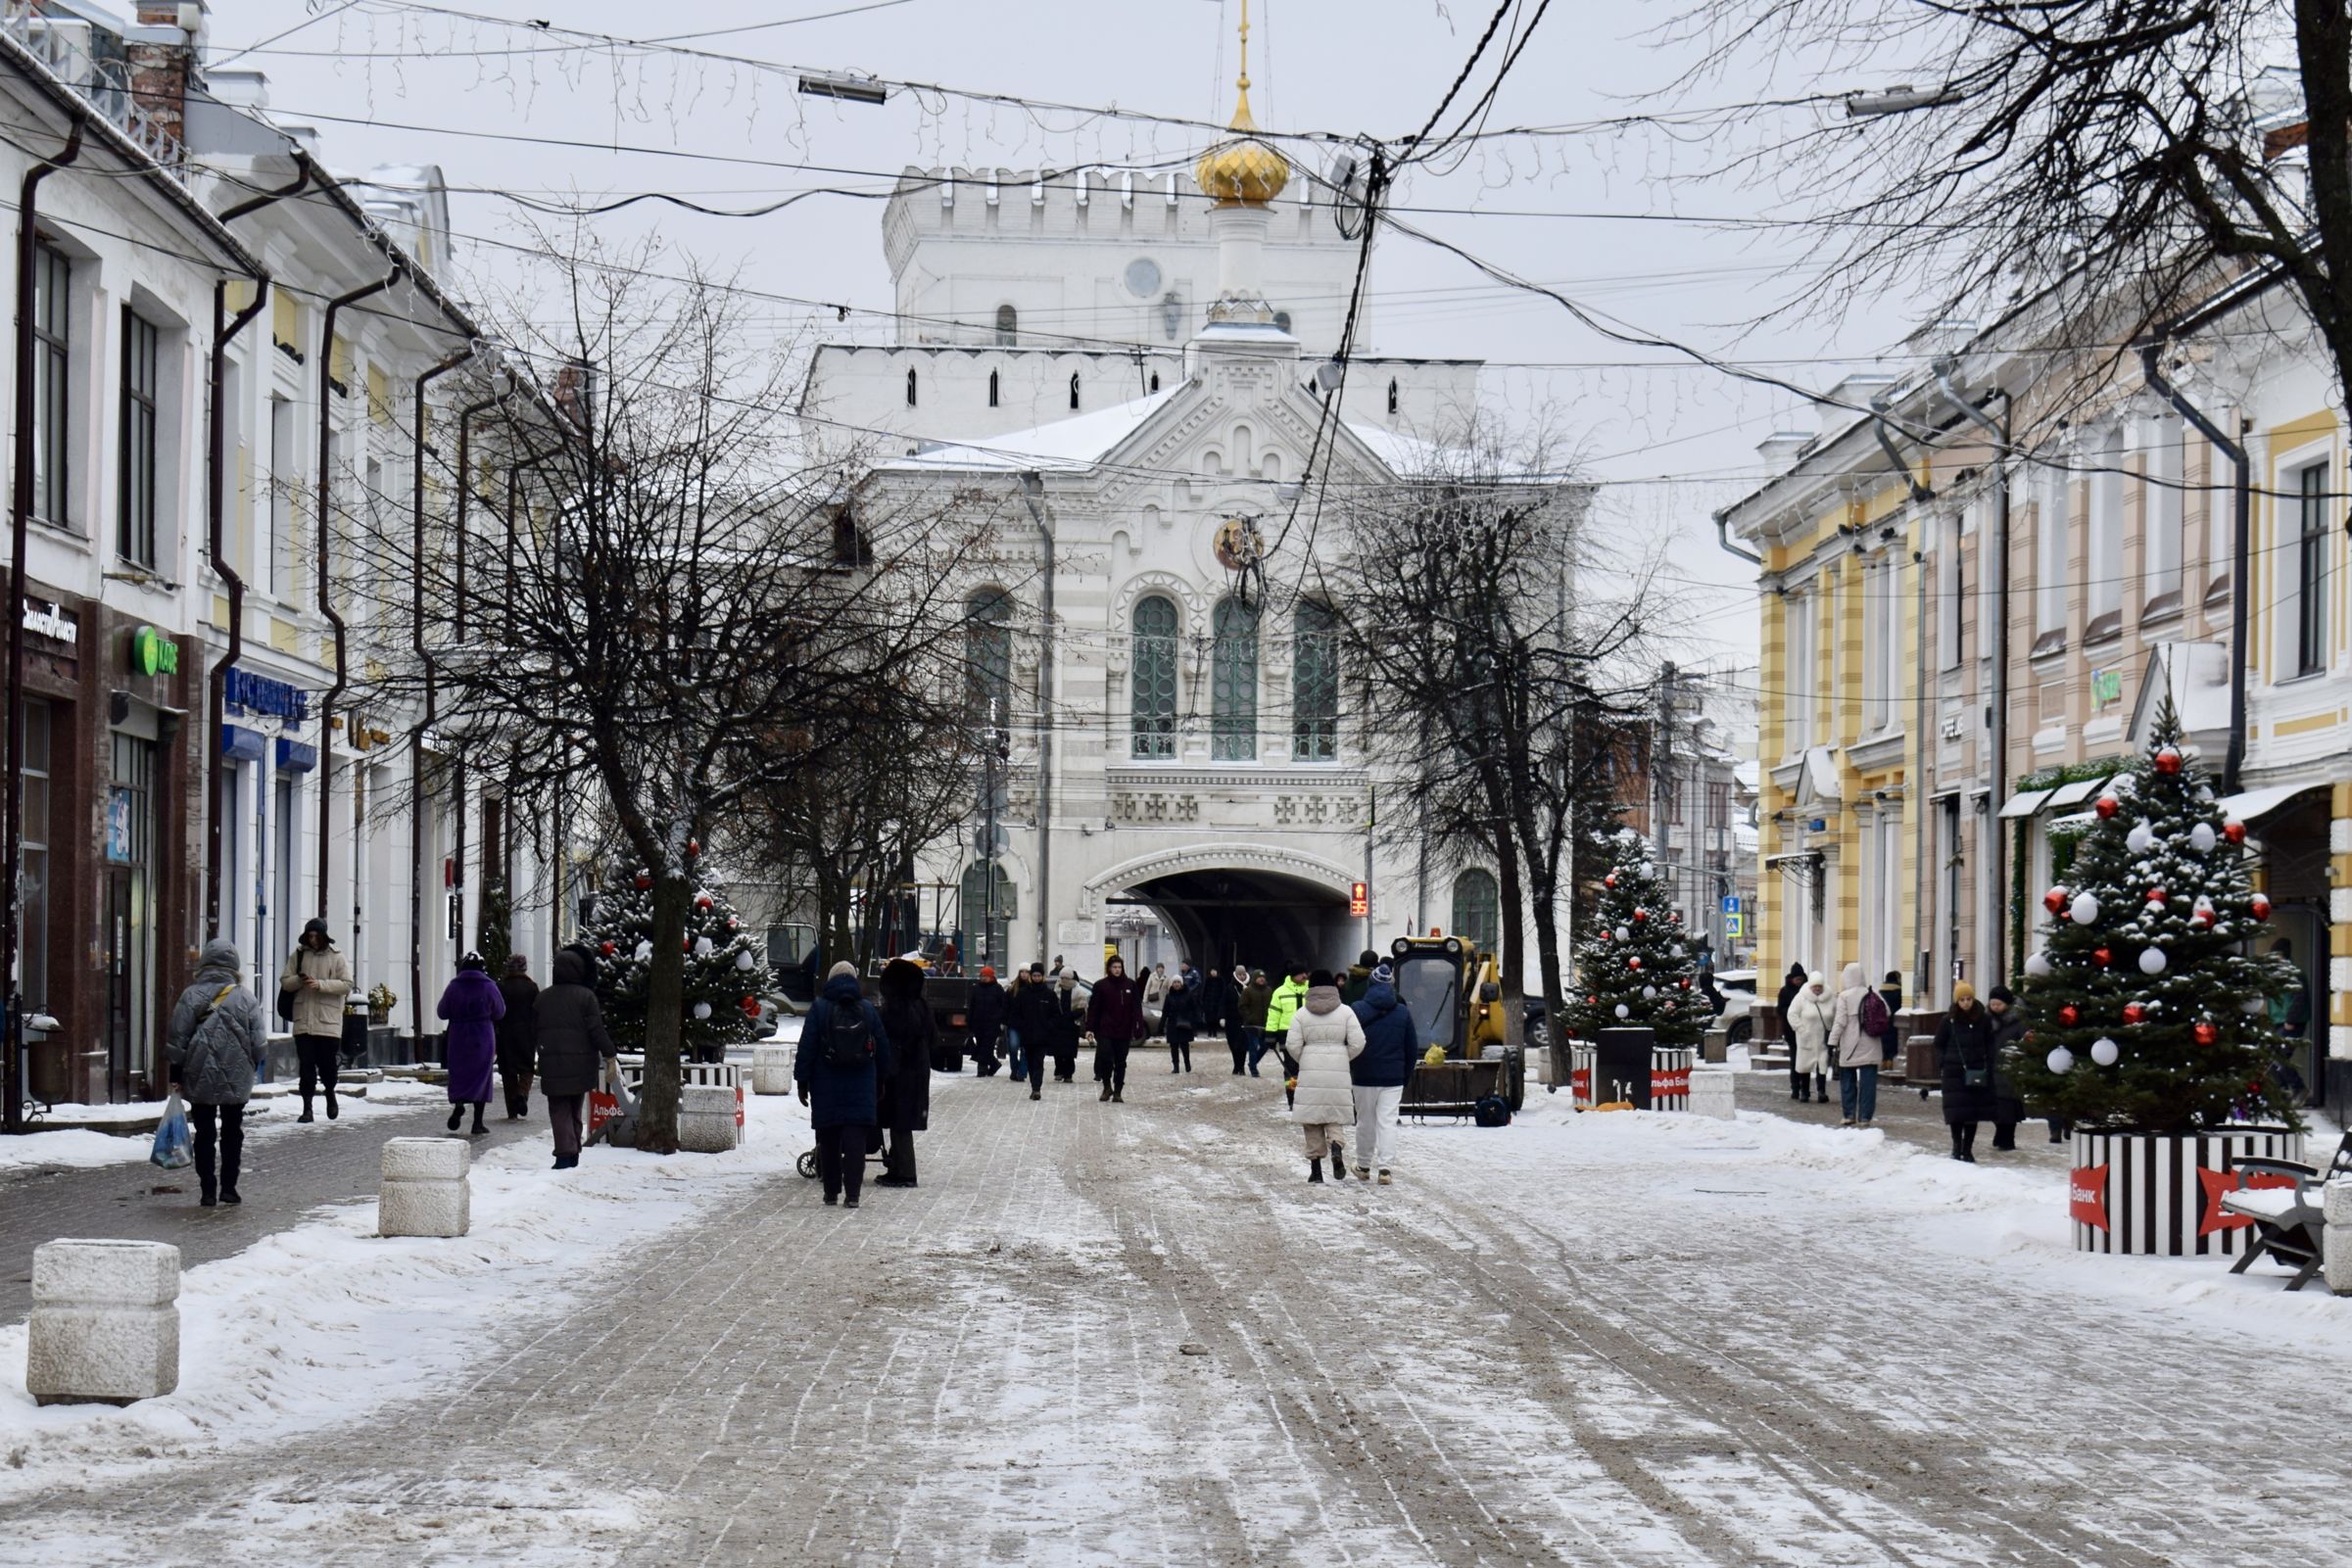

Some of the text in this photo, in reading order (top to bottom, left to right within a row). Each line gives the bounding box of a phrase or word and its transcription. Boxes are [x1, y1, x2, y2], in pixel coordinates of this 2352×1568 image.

[158, 640, 178, 674] КАФЕ
[1352, 900, 1367, 915] 35
[2072, 1182, 2096, 1205] Банк
